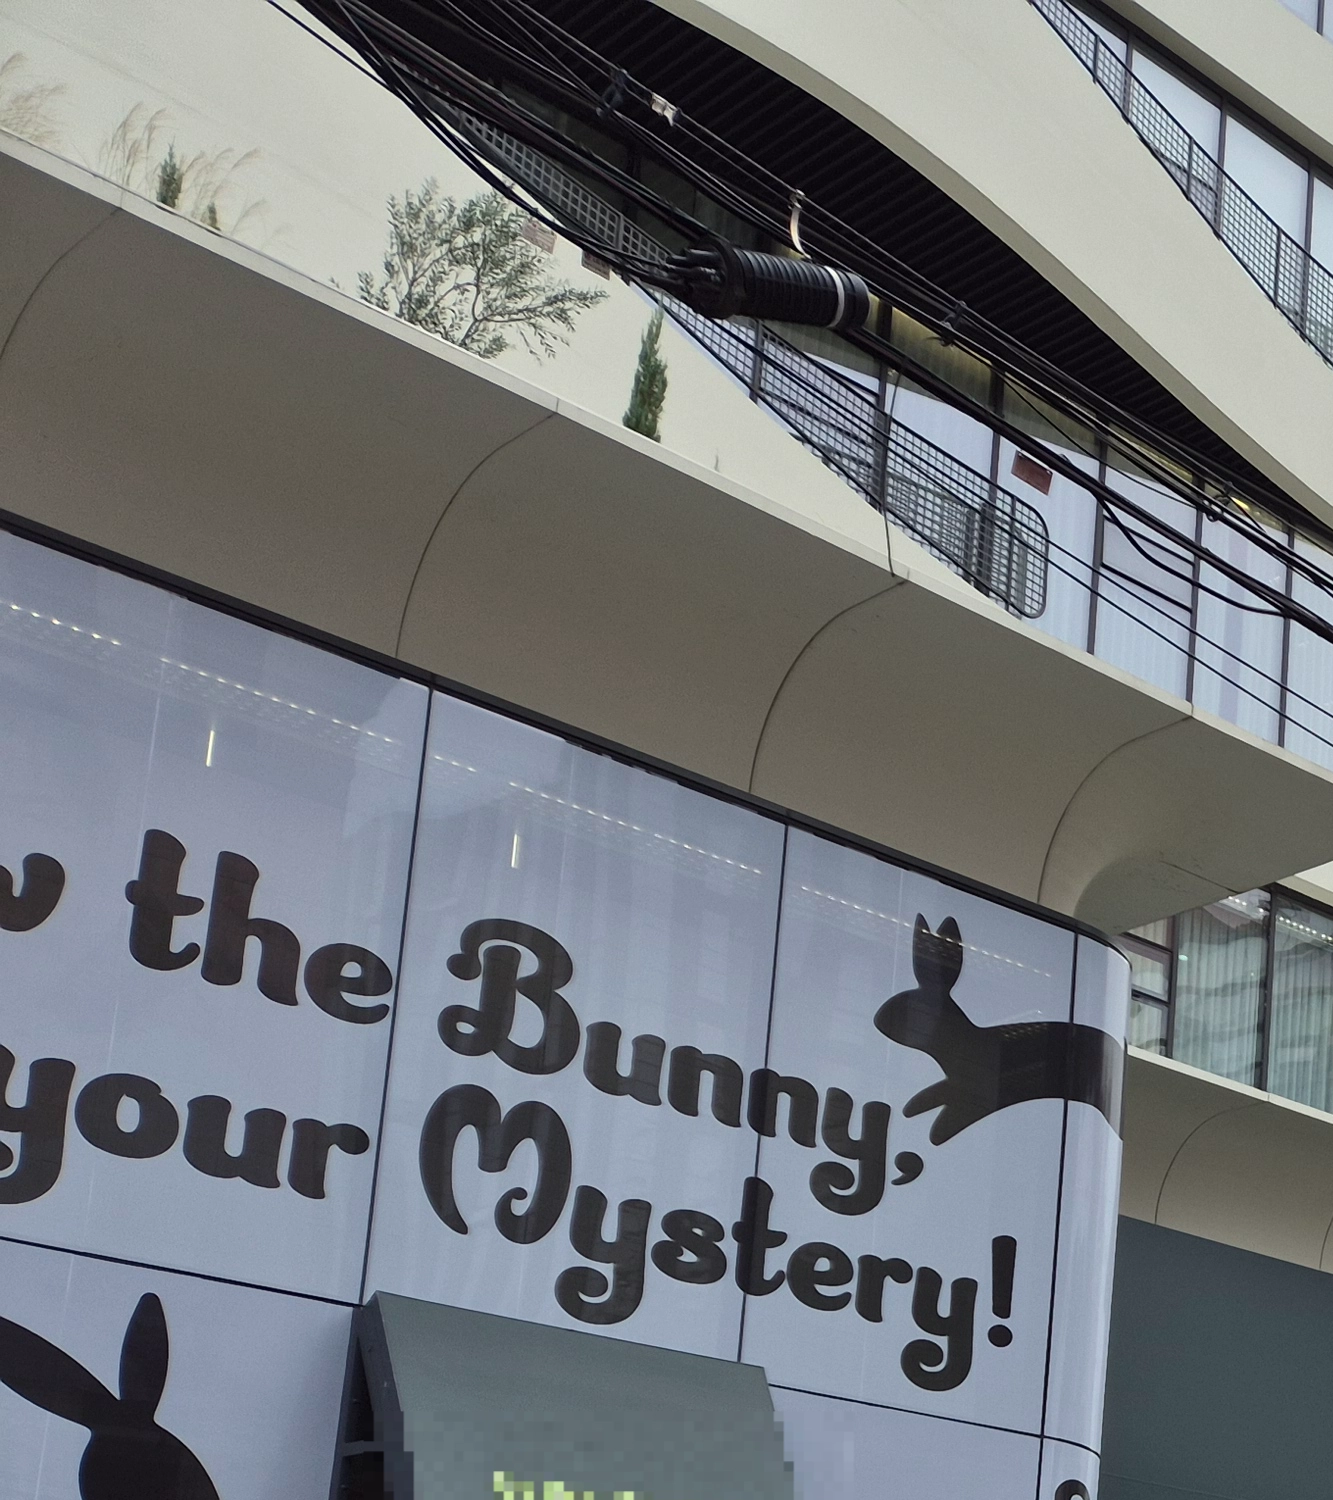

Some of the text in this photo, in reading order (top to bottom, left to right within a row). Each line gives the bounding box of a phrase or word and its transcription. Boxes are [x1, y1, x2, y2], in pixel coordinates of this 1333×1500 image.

[125, 829, 925, 1216] the Bunny,
[0, 1044, 1018, 1392] your Mystery!
